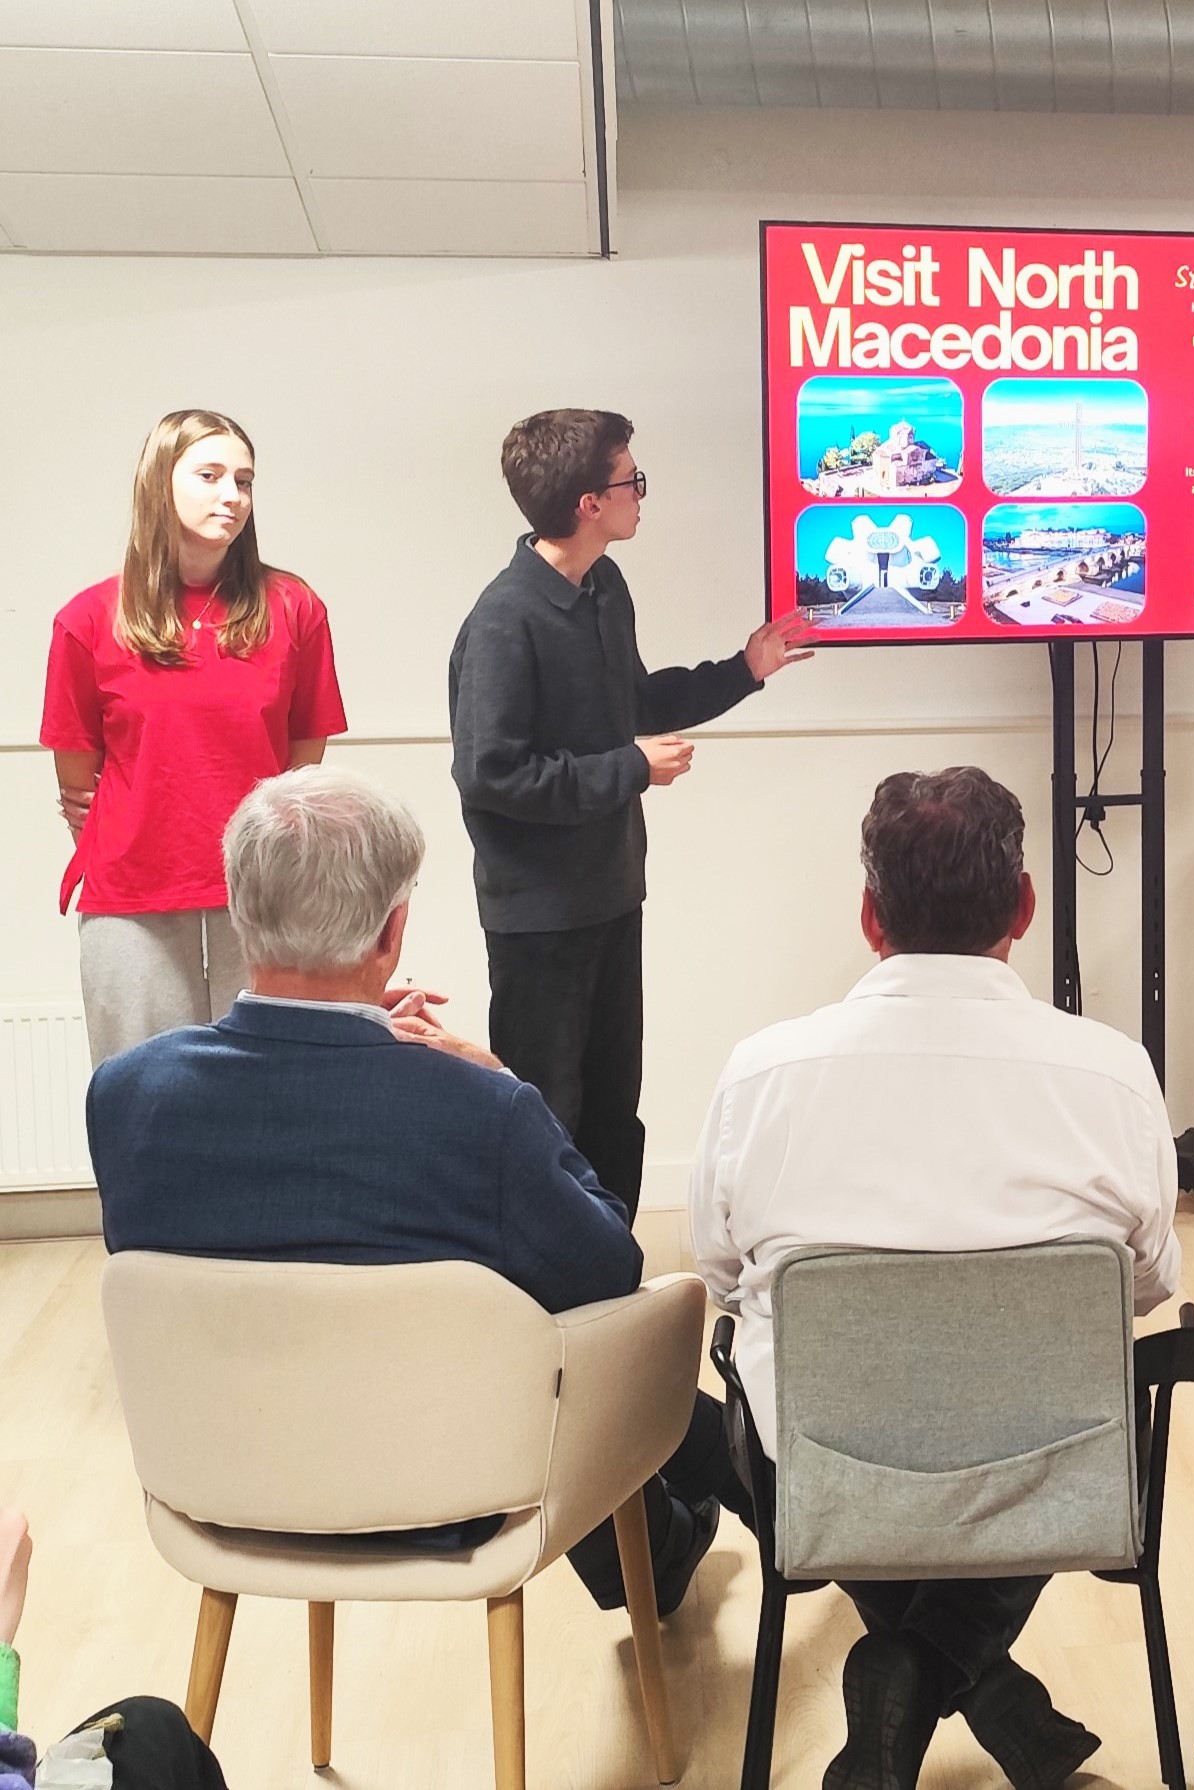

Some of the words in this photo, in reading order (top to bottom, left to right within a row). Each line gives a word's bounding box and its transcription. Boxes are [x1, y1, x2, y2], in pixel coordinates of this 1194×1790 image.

[801, 242, 940, 306] Visit
[968, 247, 1139, 310] North
[789, 306, 1139, 371] Macedonia
